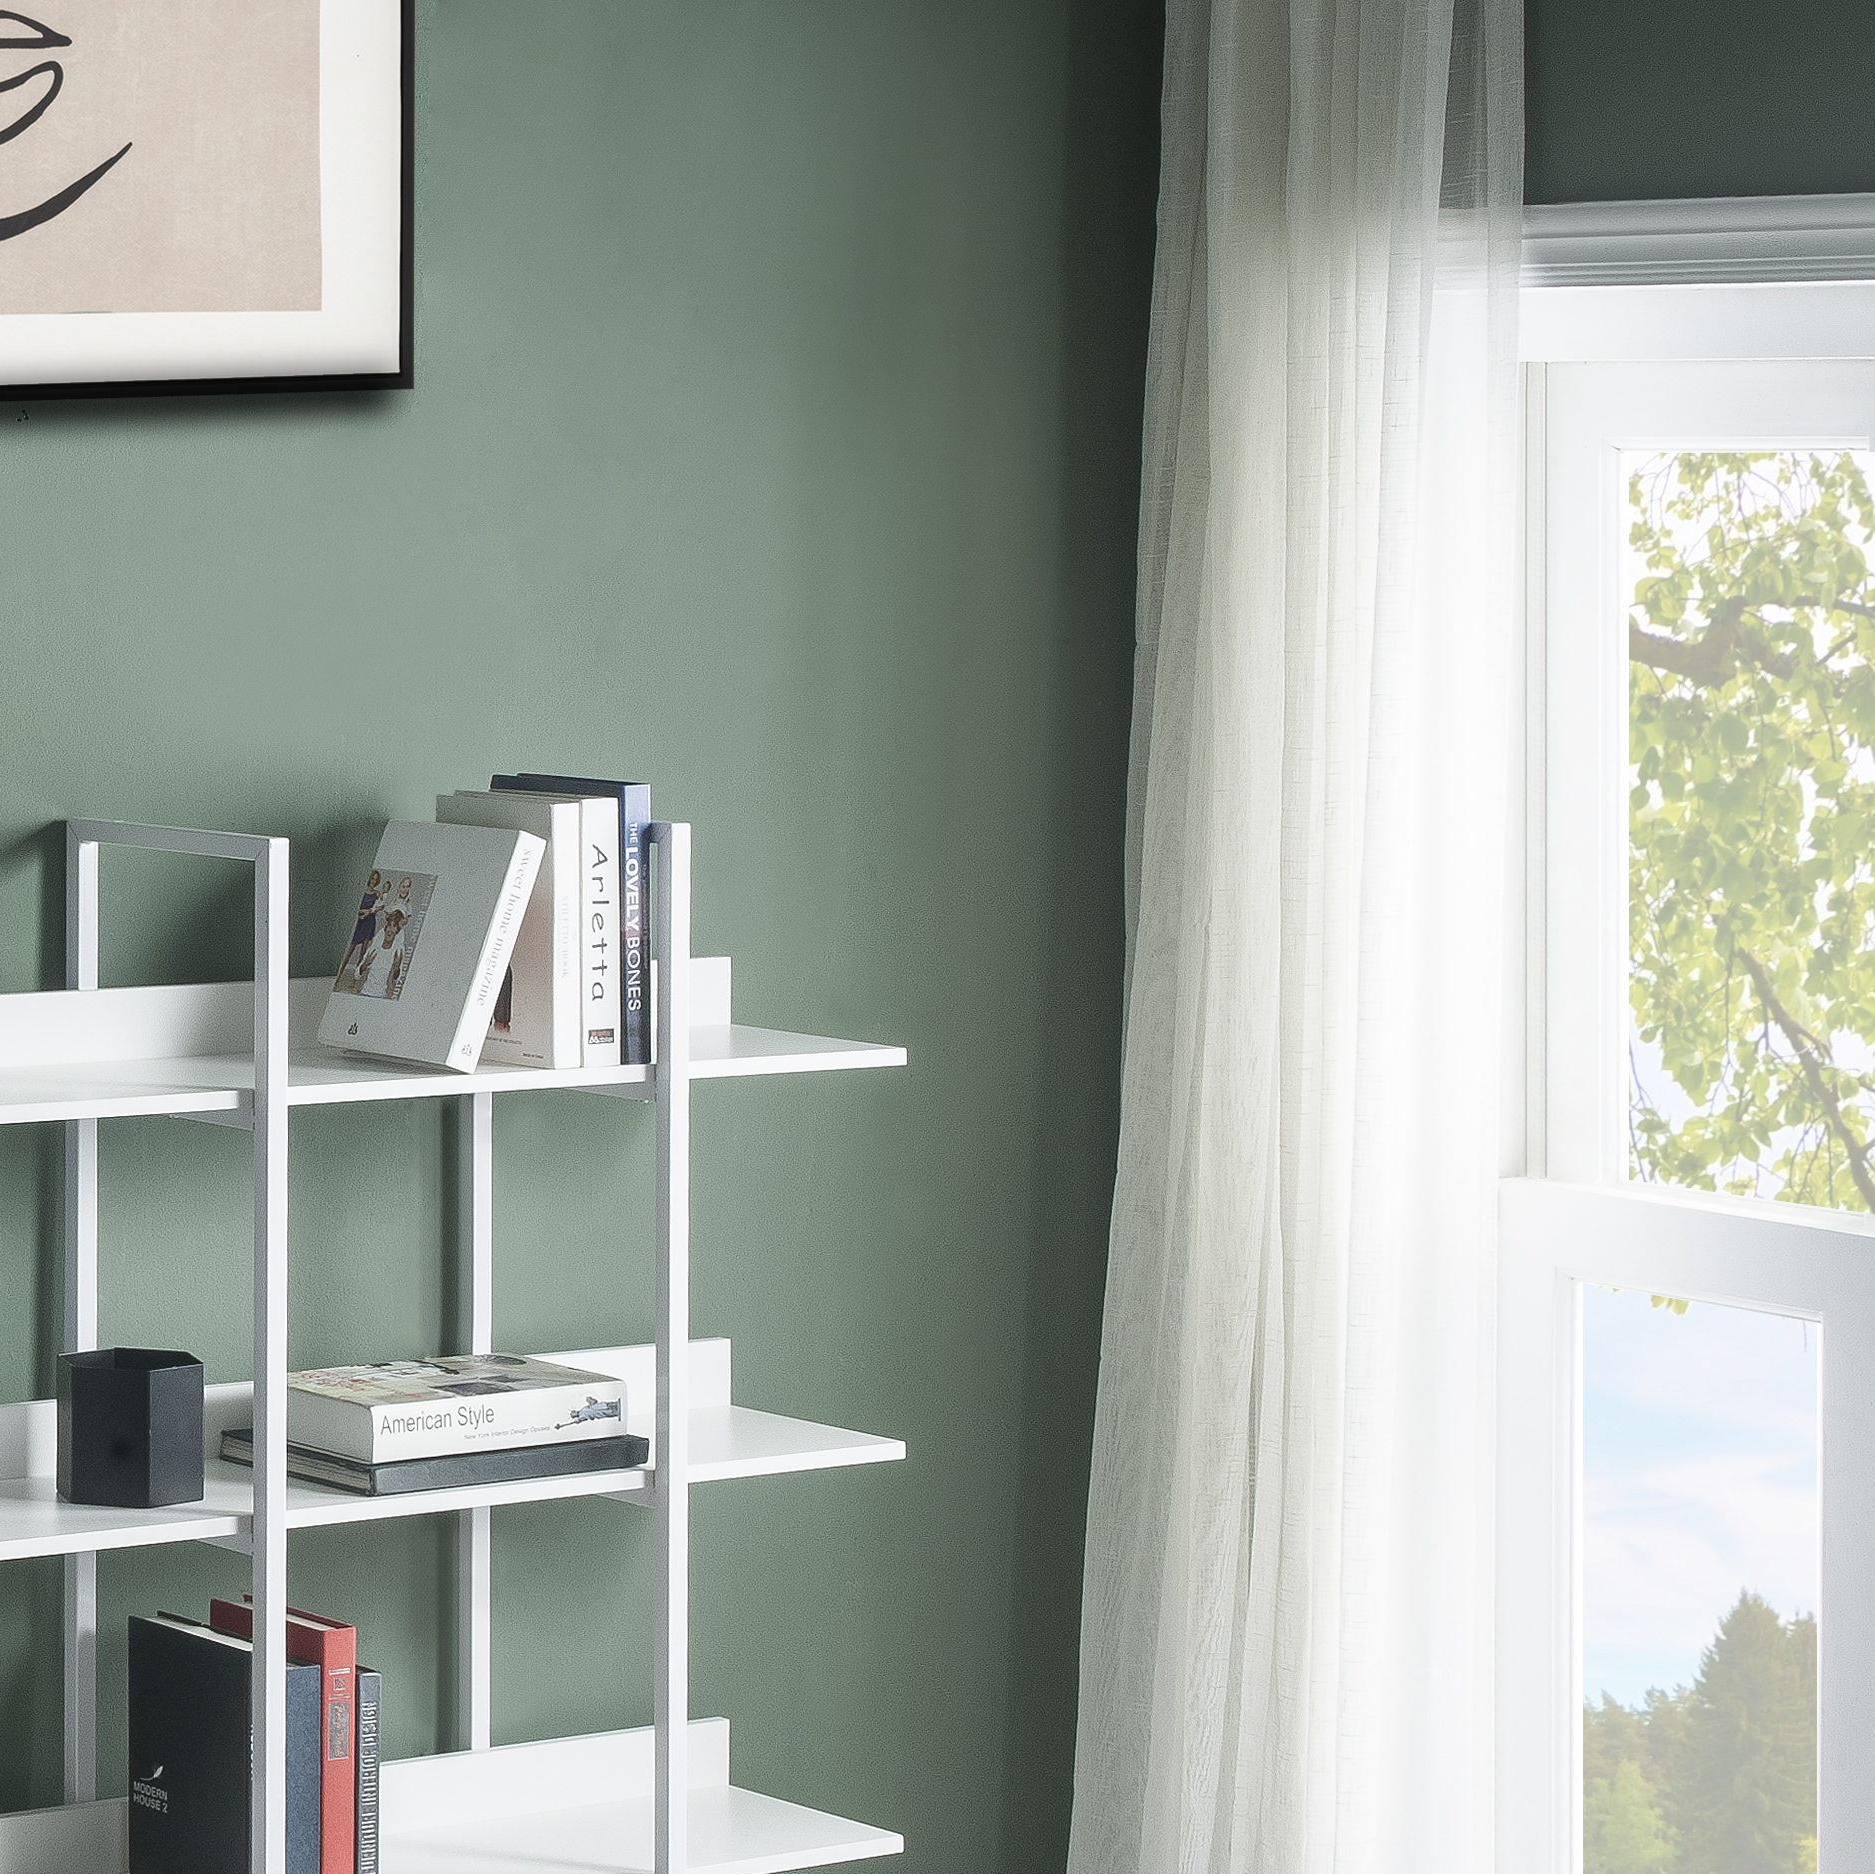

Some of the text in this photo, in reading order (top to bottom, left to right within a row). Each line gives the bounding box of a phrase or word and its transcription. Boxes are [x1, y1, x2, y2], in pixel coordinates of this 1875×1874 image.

[476, 849, 531, 1006] sweet home magazine
[591, 844, 610, 1001] Arletta
[626, 822, 642, 1011] THE LOVELY BONES
[380, 1405, 495, 1435] American Style
[133, 1781, 167, 1801] MODERN
[133, 1793, 161, 1810] HOUSE
